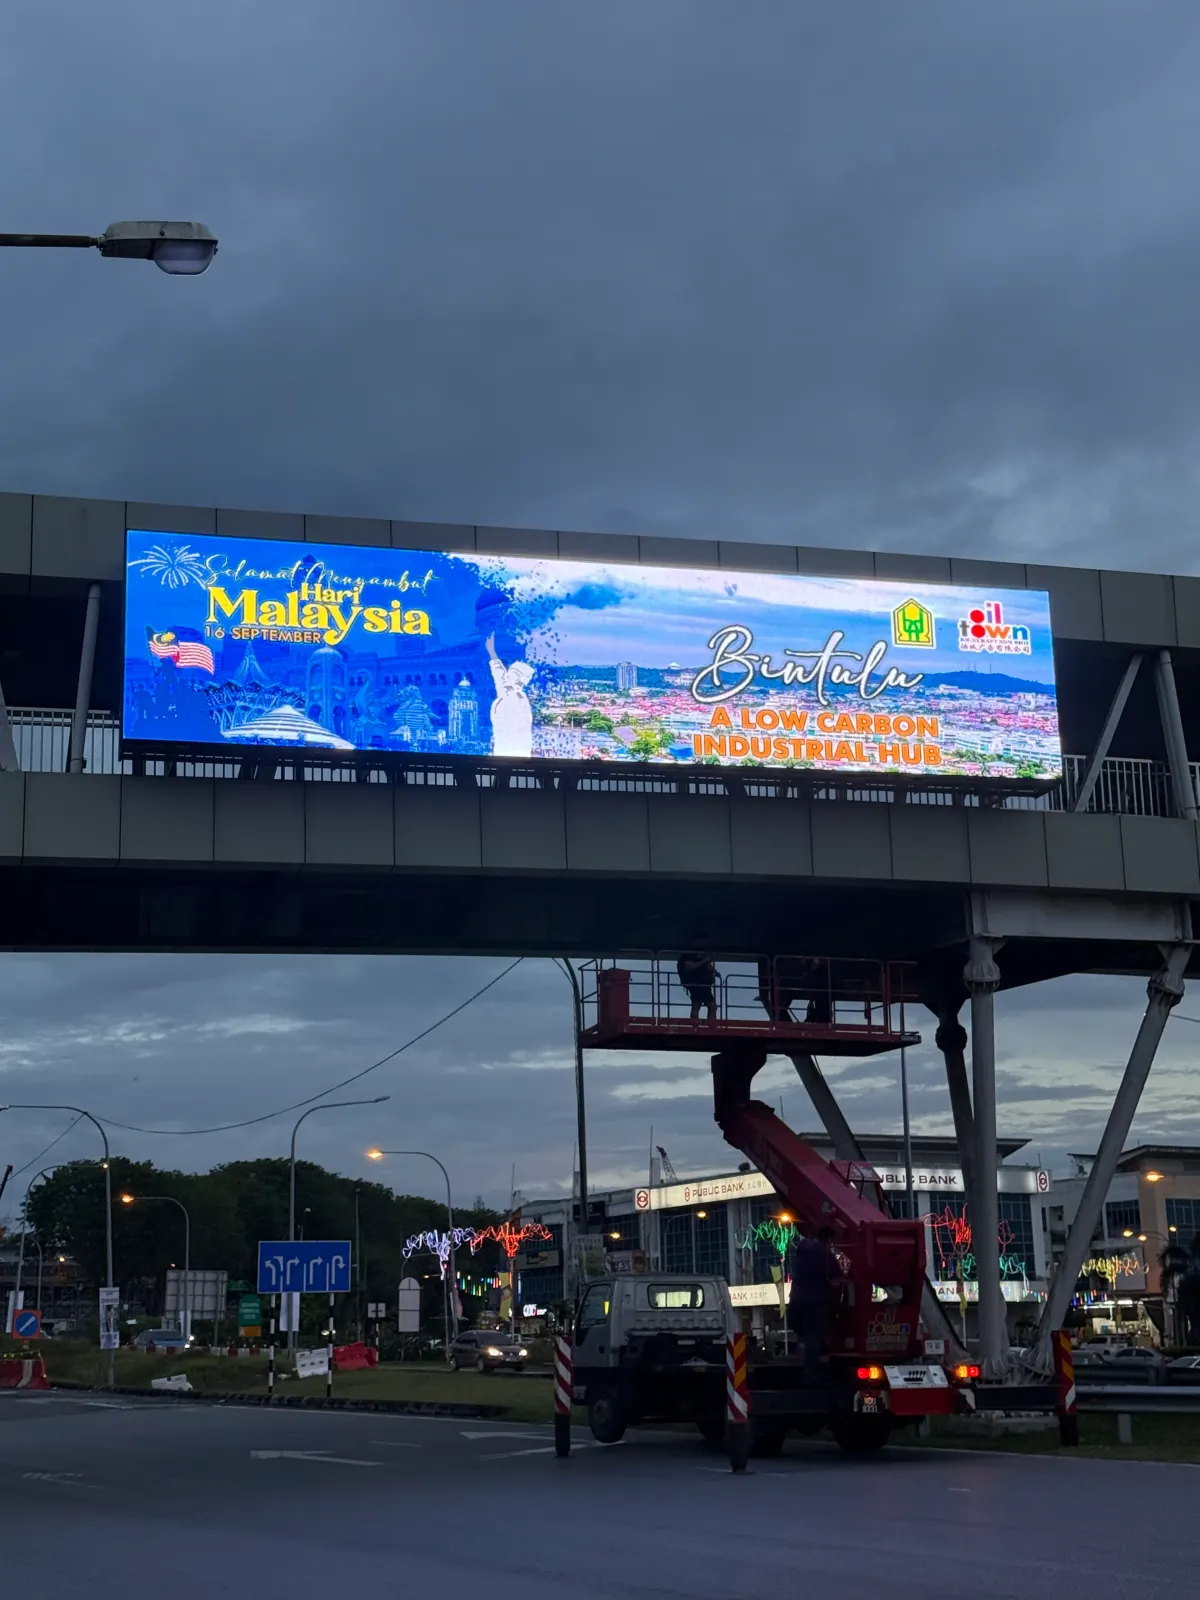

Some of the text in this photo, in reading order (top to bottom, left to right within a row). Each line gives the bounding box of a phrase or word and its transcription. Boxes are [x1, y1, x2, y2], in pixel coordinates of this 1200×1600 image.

[204, 553, 440, 596] Selamat Menyambut
[300, 582, 361, 605] Hari
[204, 585, 433, 646] Malaysia
[970, 602, 1001, 624] oil
[204, 625, 324, 644] 16 SEPTEMBER
[959, 620, 1028, 640] town
[691, 624, 925, 706] Bintulu
[710, 706, 940, 738] A LOW CARBON
[693, 734, 943, 766] INDUSTRIAL HUB
[692, 1182, 745, 1198] PUBLIC BANK
[919, 1175, 959, 1185] BANK
[731, 1292, 748, 1301] ANK
